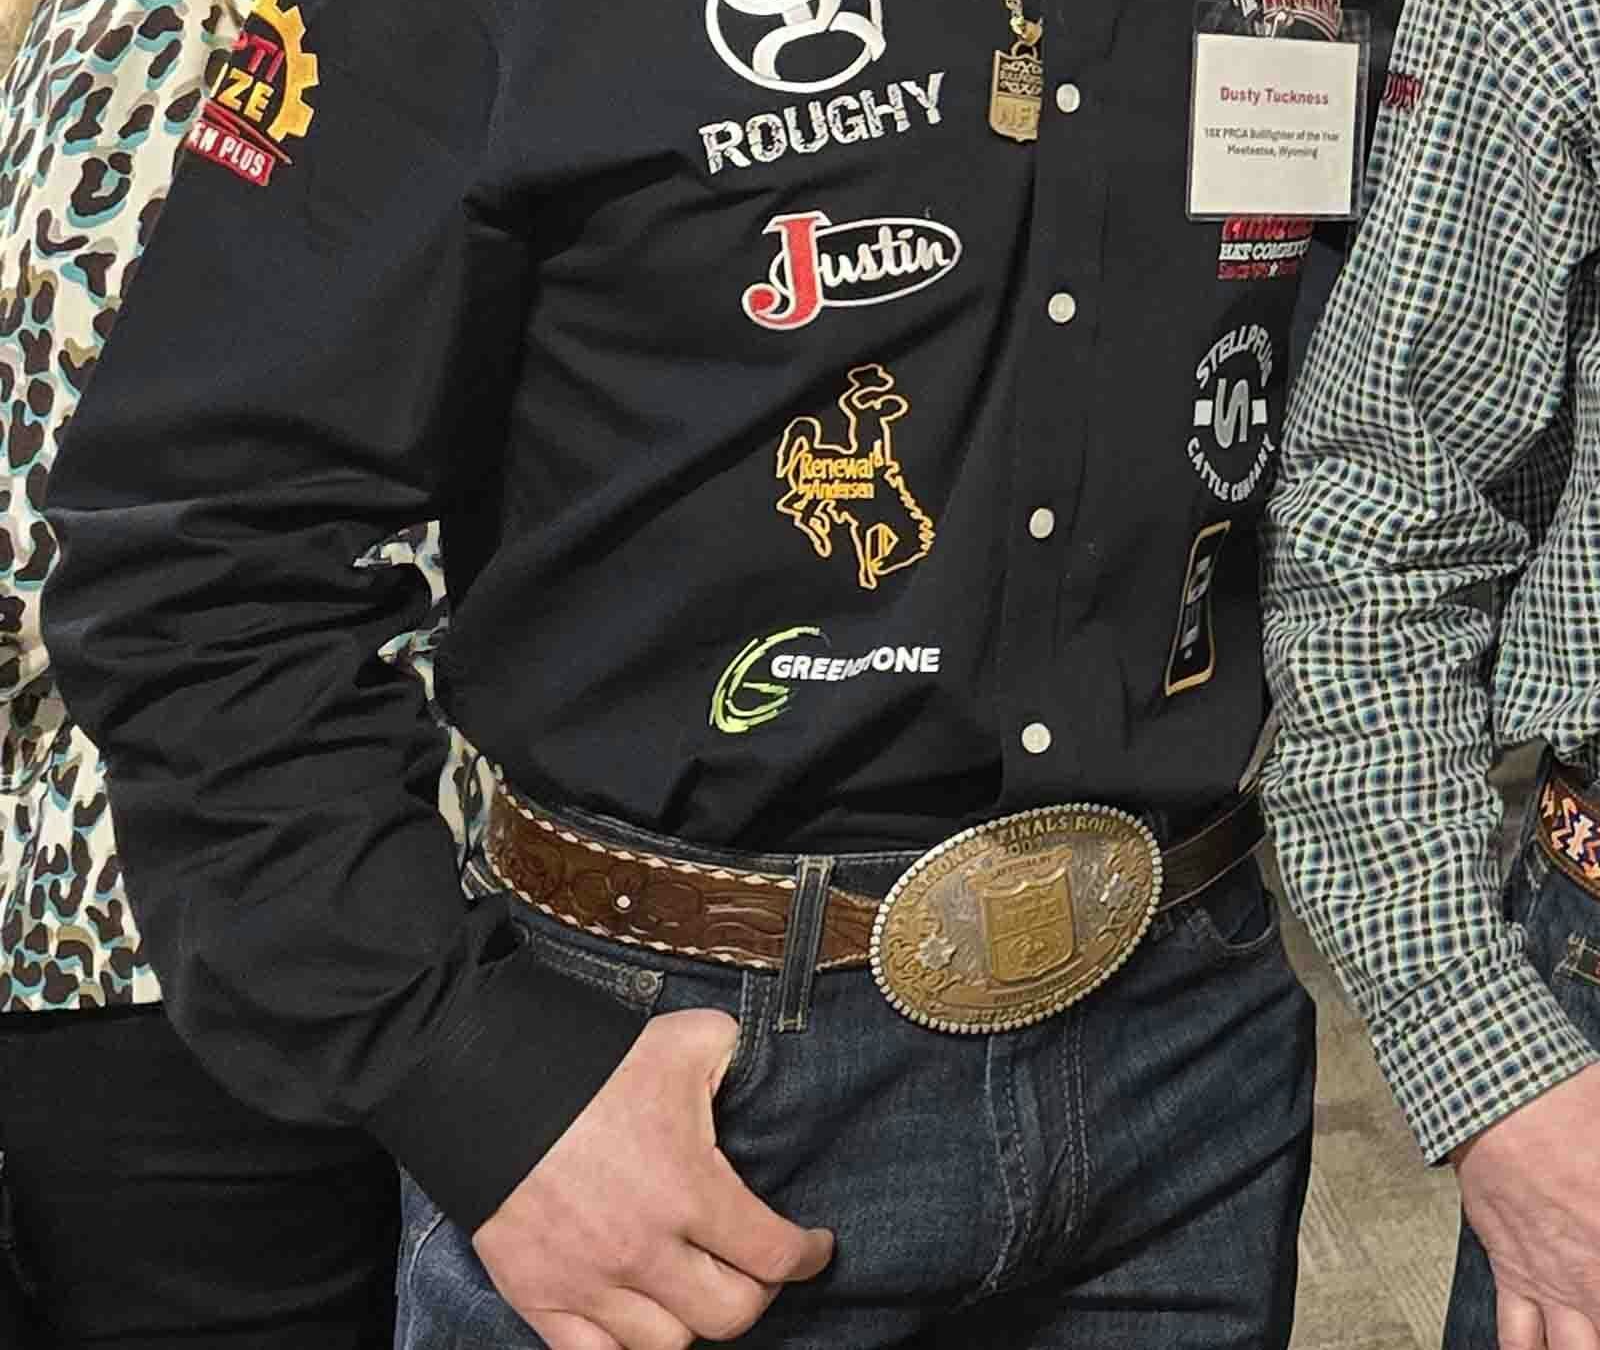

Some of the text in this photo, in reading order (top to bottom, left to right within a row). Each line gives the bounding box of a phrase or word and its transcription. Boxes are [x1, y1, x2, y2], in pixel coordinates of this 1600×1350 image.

[211, 62, 273, 122] IZE
[1220, 87, 1329, 106] Dusty Tuckness
[699, 72, 944, 174] ROUGHY
[219, 133, 266, 177] PLUS
[742, 210, 951, 330] Justin
[800, 452, 874, 479] Renewal
[997, 816, 1069, 845] FINALS
